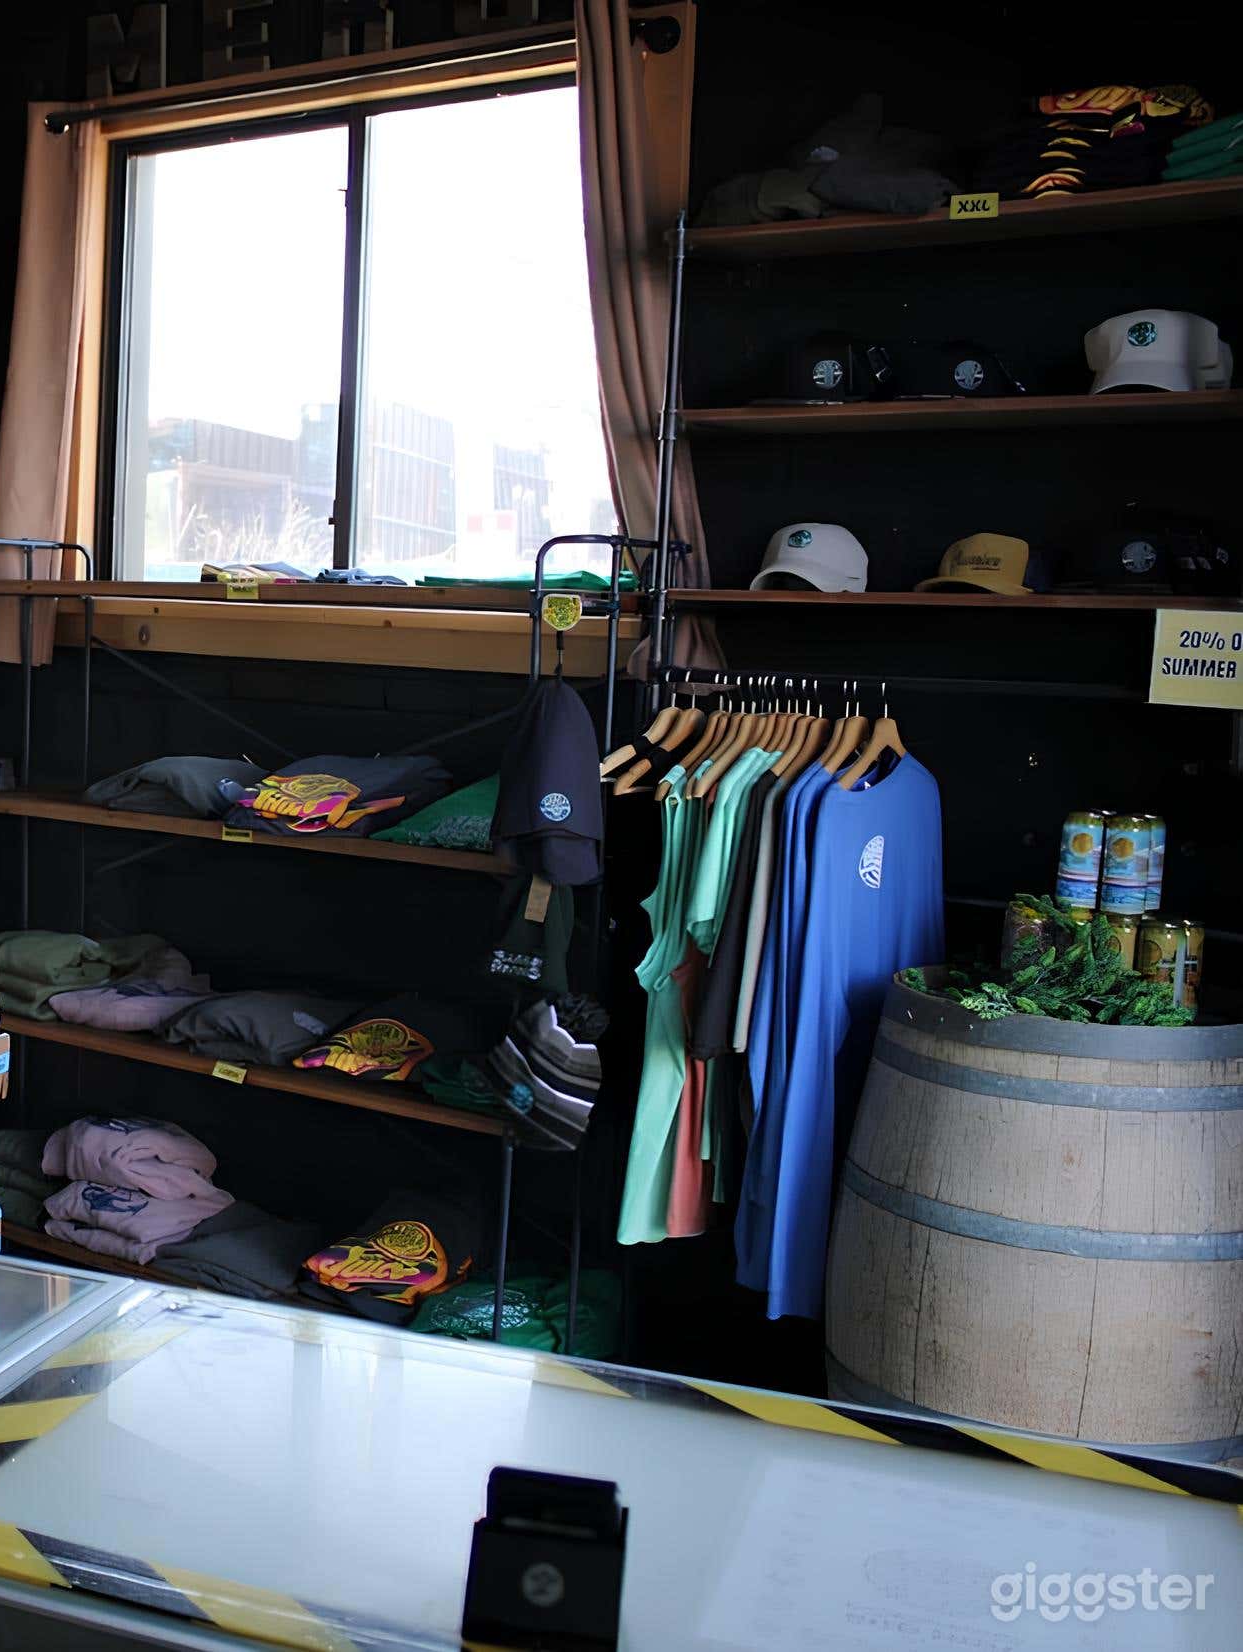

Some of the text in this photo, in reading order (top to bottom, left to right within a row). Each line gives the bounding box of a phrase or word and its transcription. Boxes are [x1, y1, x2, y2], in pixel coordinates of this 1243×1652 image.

[957, 199, 990, 214] XXL
[1179, 630, 1226, 651] 20%
[1161, 657, 1237, 679] SUMMER
